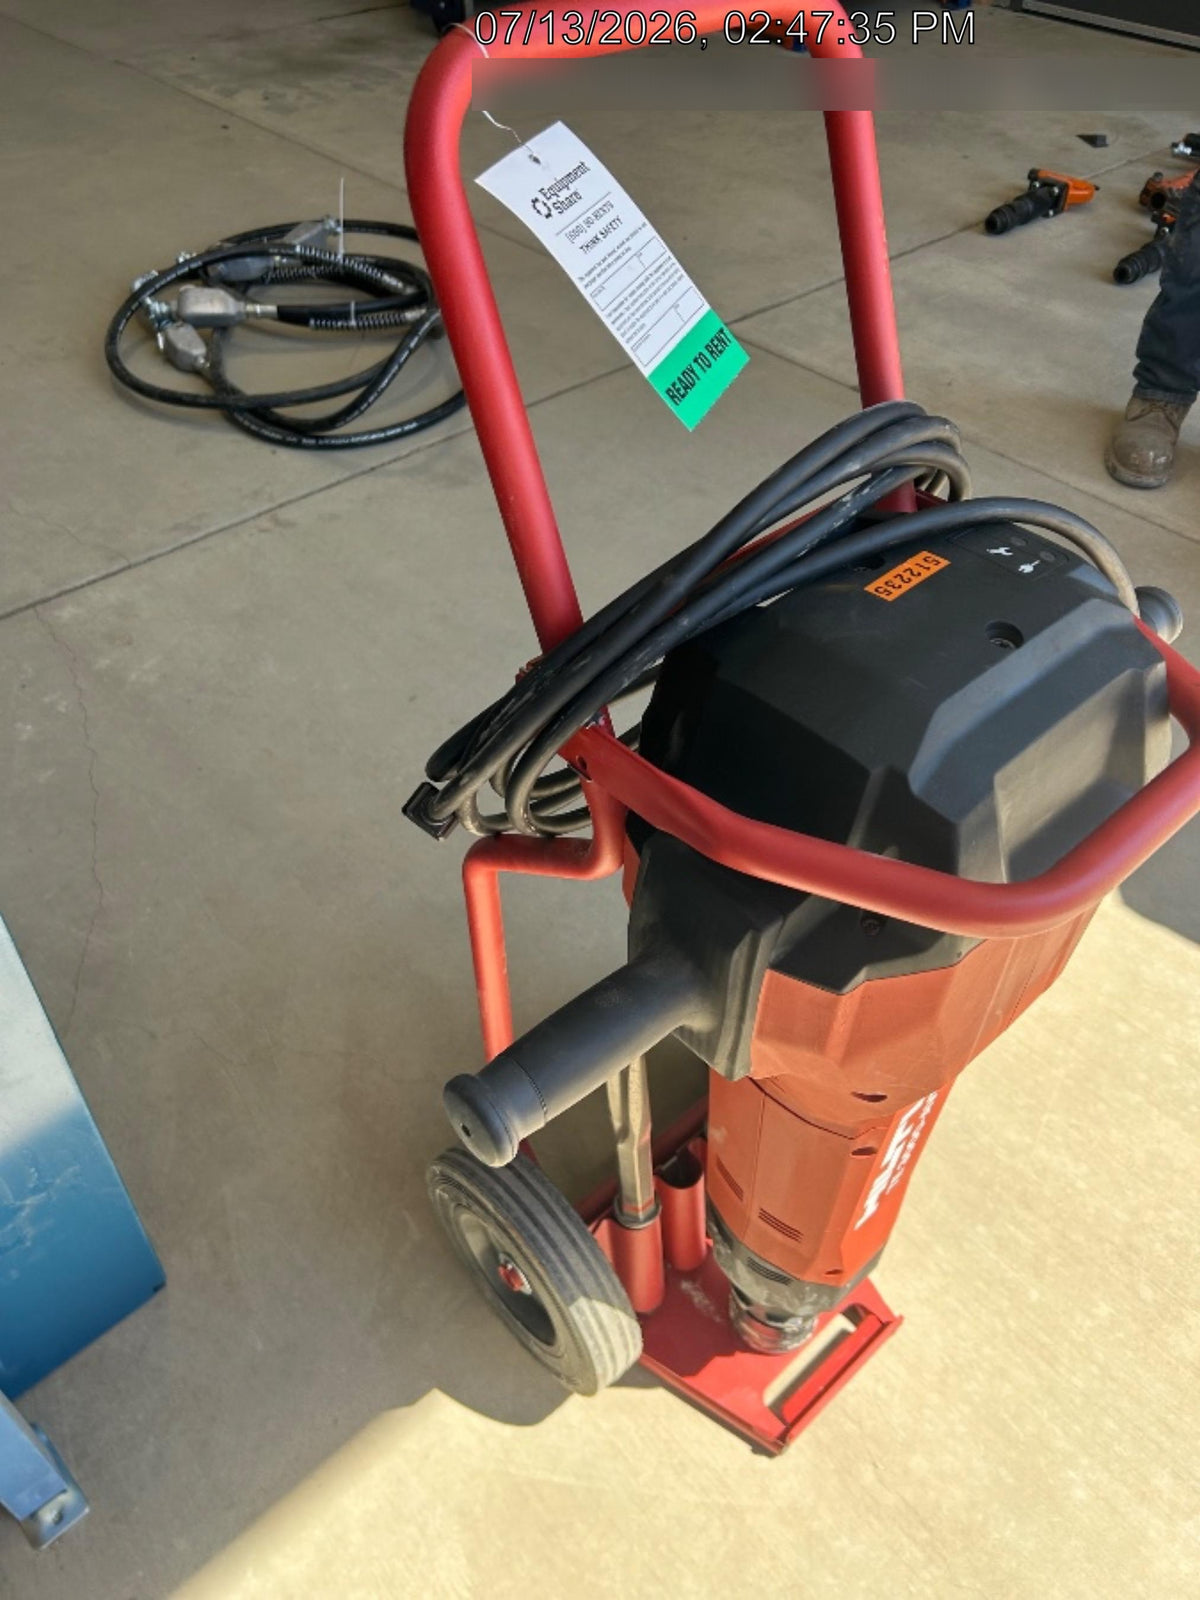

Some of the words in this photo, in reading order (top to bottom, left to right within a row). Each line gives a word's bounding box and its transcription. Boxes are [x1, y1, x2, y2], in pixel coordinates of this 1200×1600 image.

[538, 161, 591, 201] Equipment
[553, 190, 583, 215] Share
[579, 232, 603, 255] THINK
[599, 215, 624, 239] SAFETY
[665, 363, 701, 406] READY
[693, 351, 712, 373] TO
[704, 327, 732, 362] RENT
[874, 555, 941, 596] 512235
